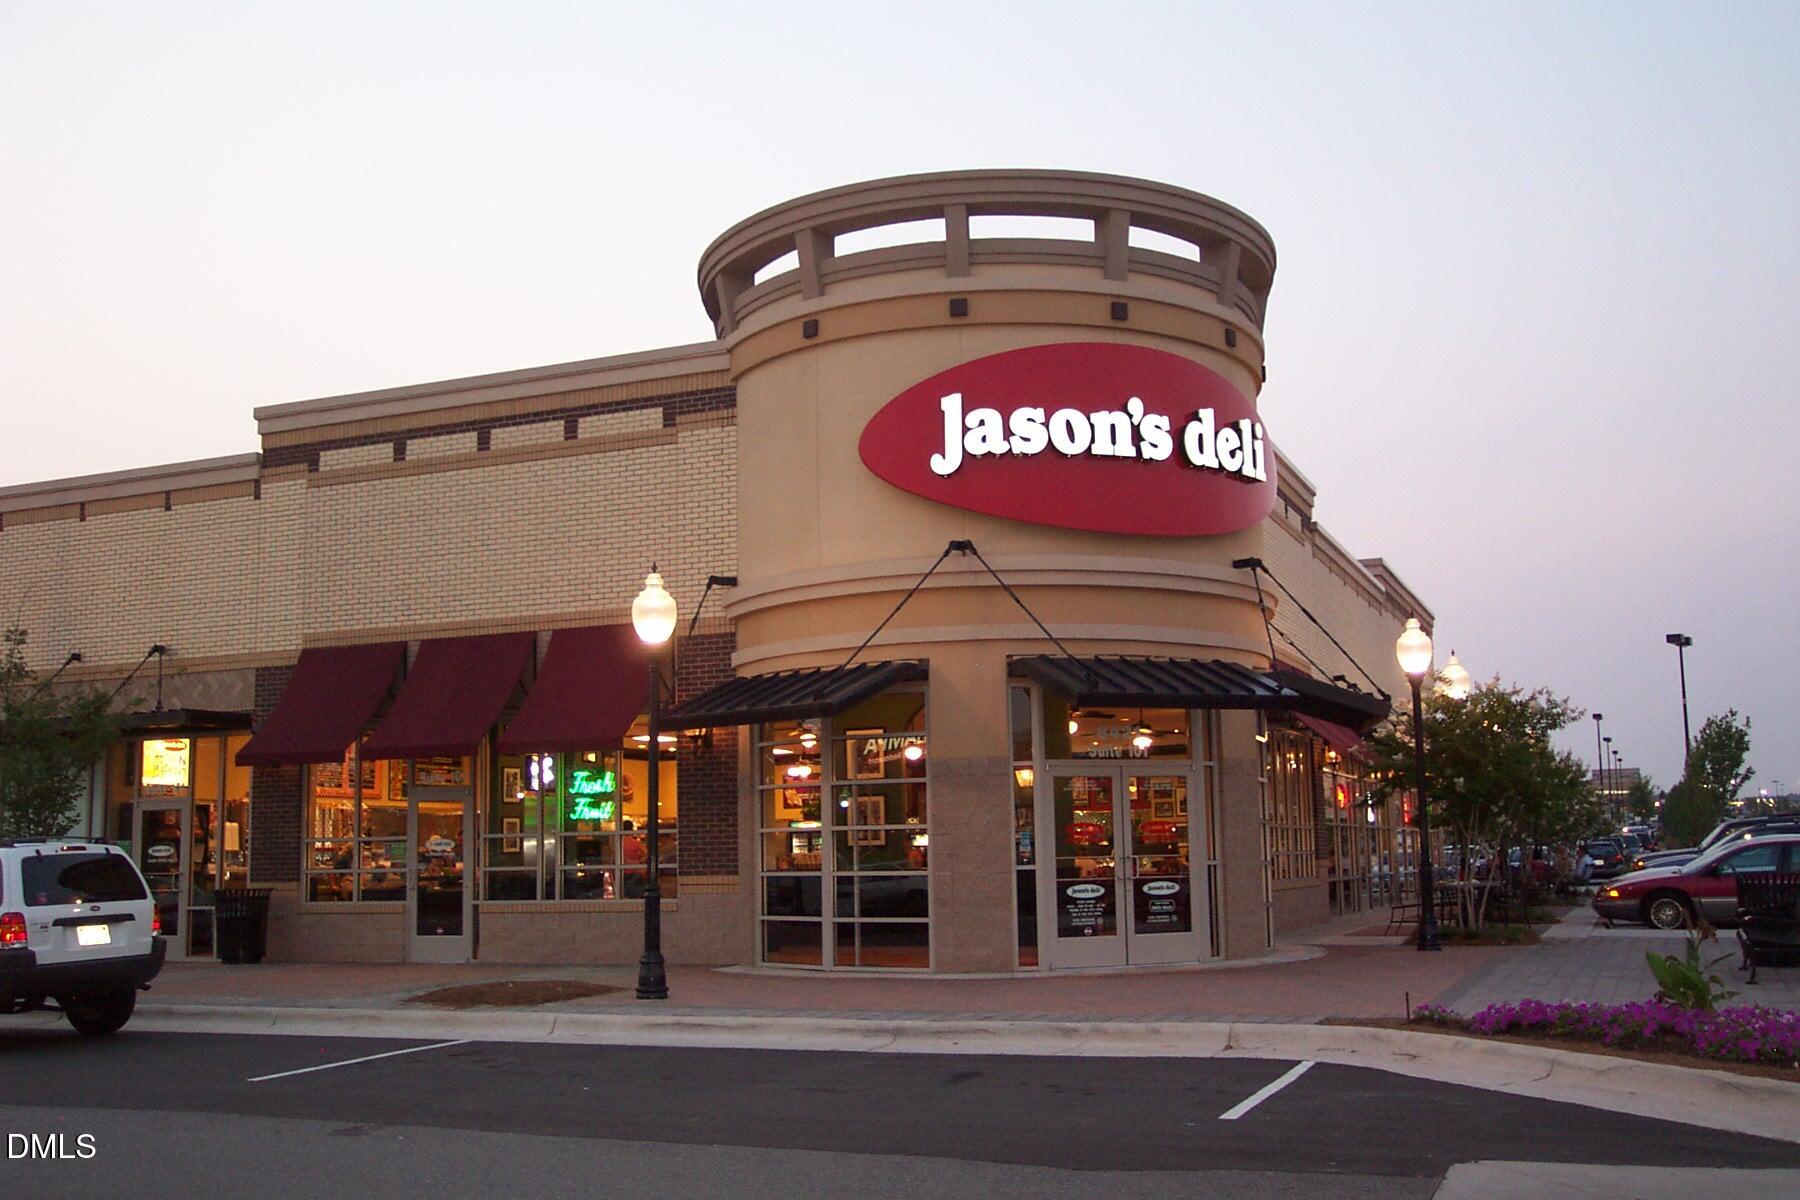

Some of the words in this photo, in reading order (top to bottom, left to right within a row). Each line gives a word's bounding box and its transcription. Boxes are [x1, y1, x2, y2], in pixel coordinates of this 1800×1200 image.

[930, 392, 1173, 476] Jason's
[1184, 407, 1267, 482] deli
[569, 771, 616, 794] Fresh
[570, 798, 616, 819] Fruit
